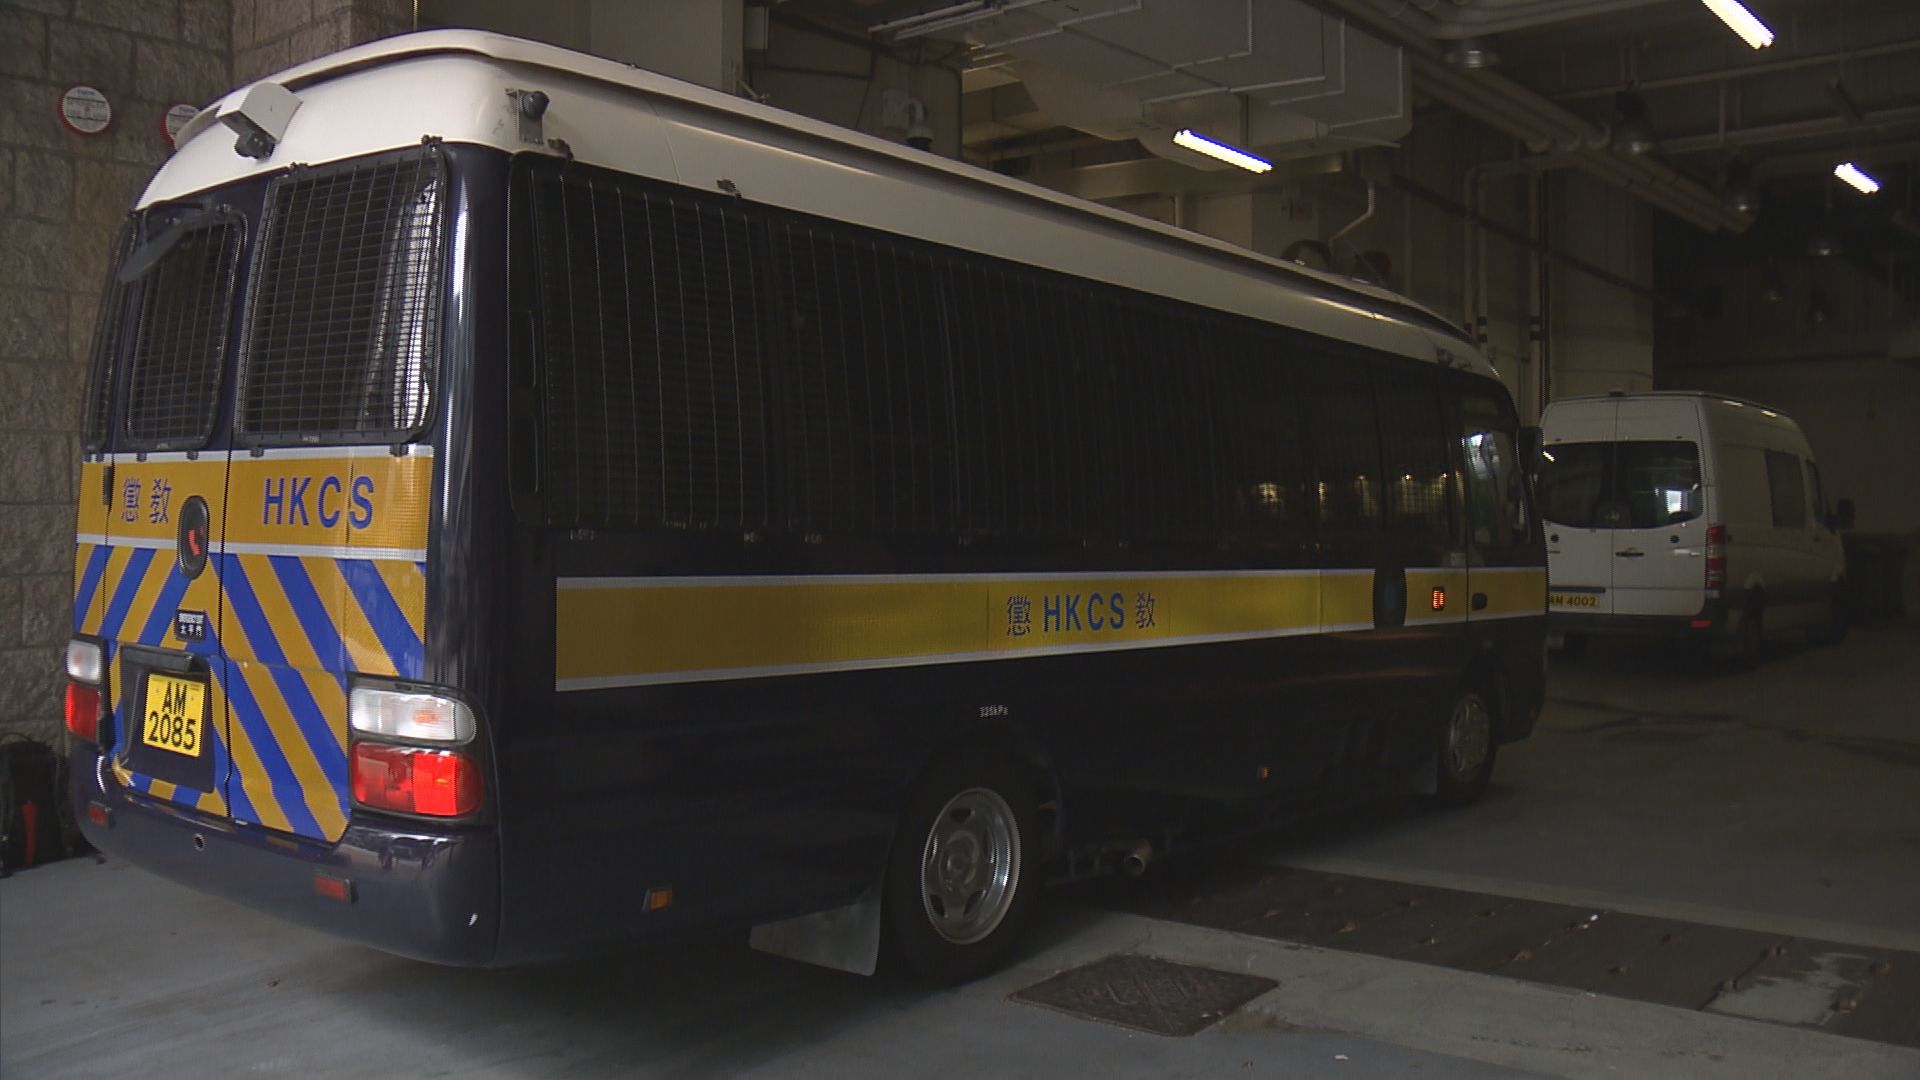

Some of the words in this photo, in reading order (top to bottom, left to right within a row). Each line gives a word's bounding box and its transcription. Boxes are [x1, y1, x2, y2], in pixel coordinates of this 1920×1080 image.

[263, 475, 376, 529] HKCS
[1007, 594, 1032, 638] 懲
[1043, 592, 1125, 632] HKCS
[1567, 595, 1596, 607] 4002
[161, 681, 188, 716] AM
[148, 710, 196, 750] 2085
